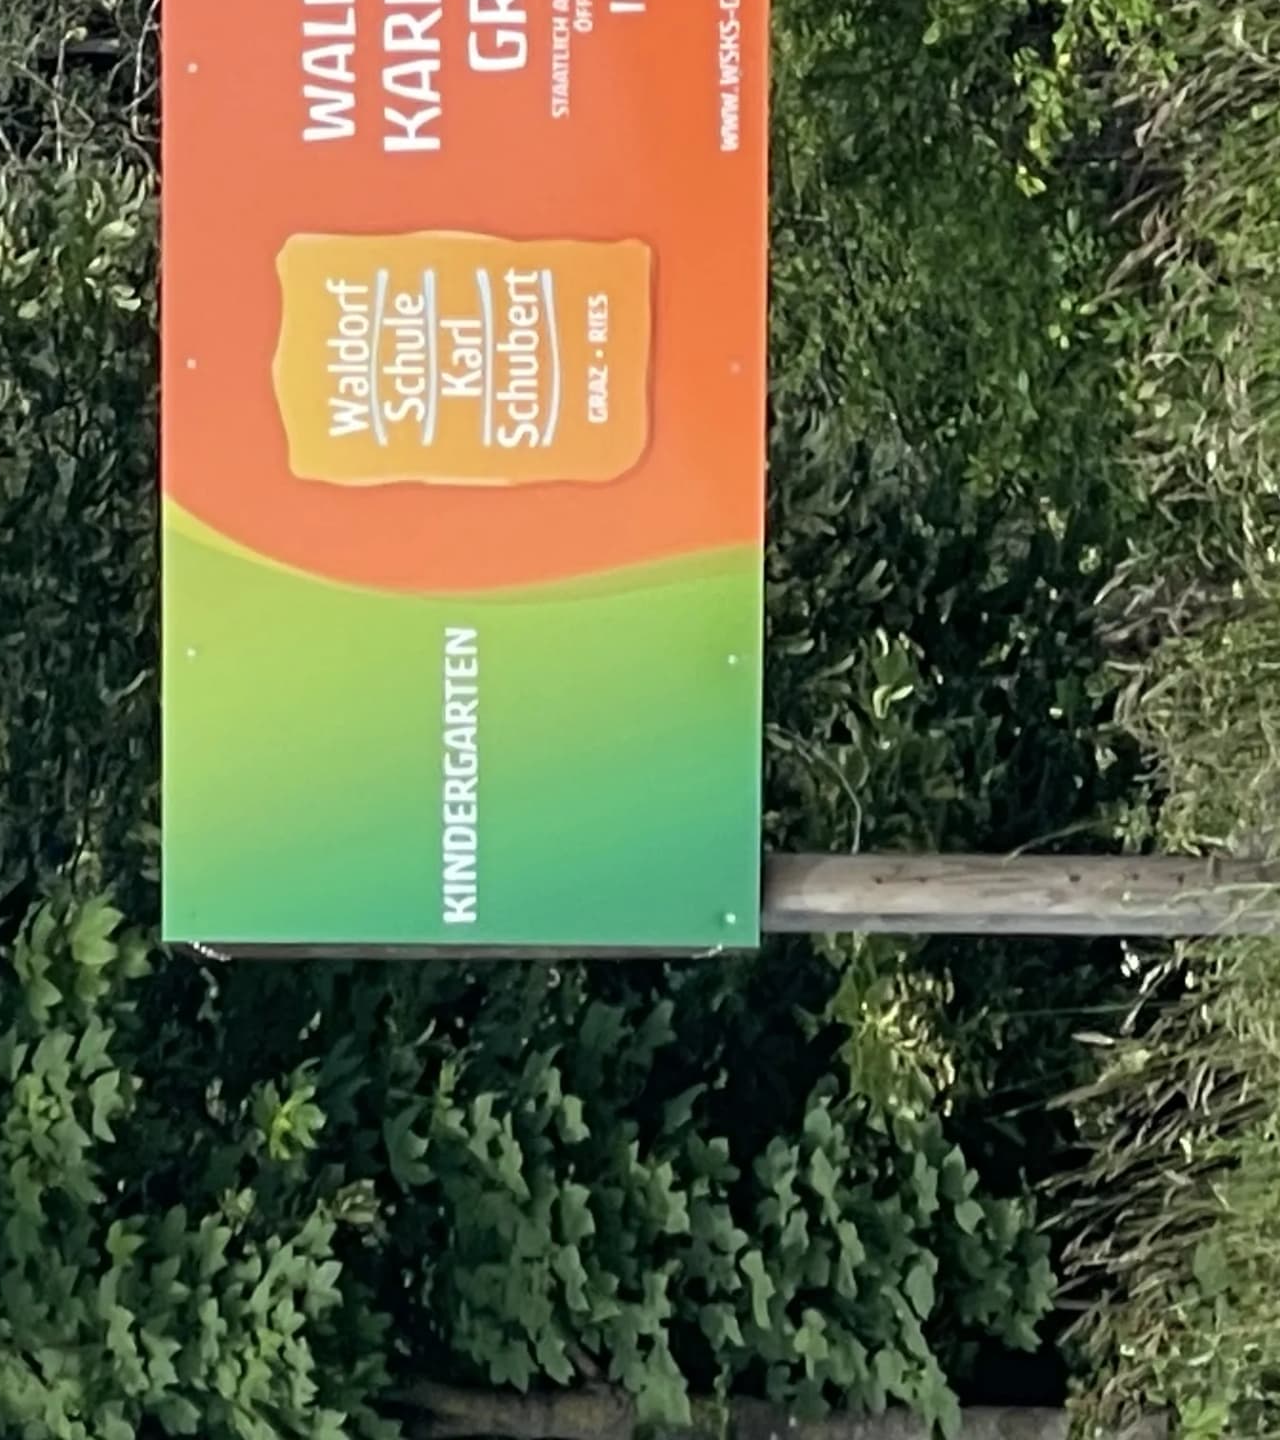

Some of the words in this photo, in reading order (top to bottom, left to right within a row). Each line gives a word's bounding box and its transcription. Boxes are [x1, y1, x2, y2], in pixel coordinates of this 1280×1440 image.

[550, 16, 570, 119] STAATLICH
[324, 277, 369, 438] Waldorf
[381, 291, 426, 424] Schule
[440, 319, 483, 397] Karl
[494, 267, 541, 449] Schubert
[586, 292, 609, 345] RIES
[587, 364, 609, 424] GRAZ
[442, 626, 479, 925] KINDERGARTEN
